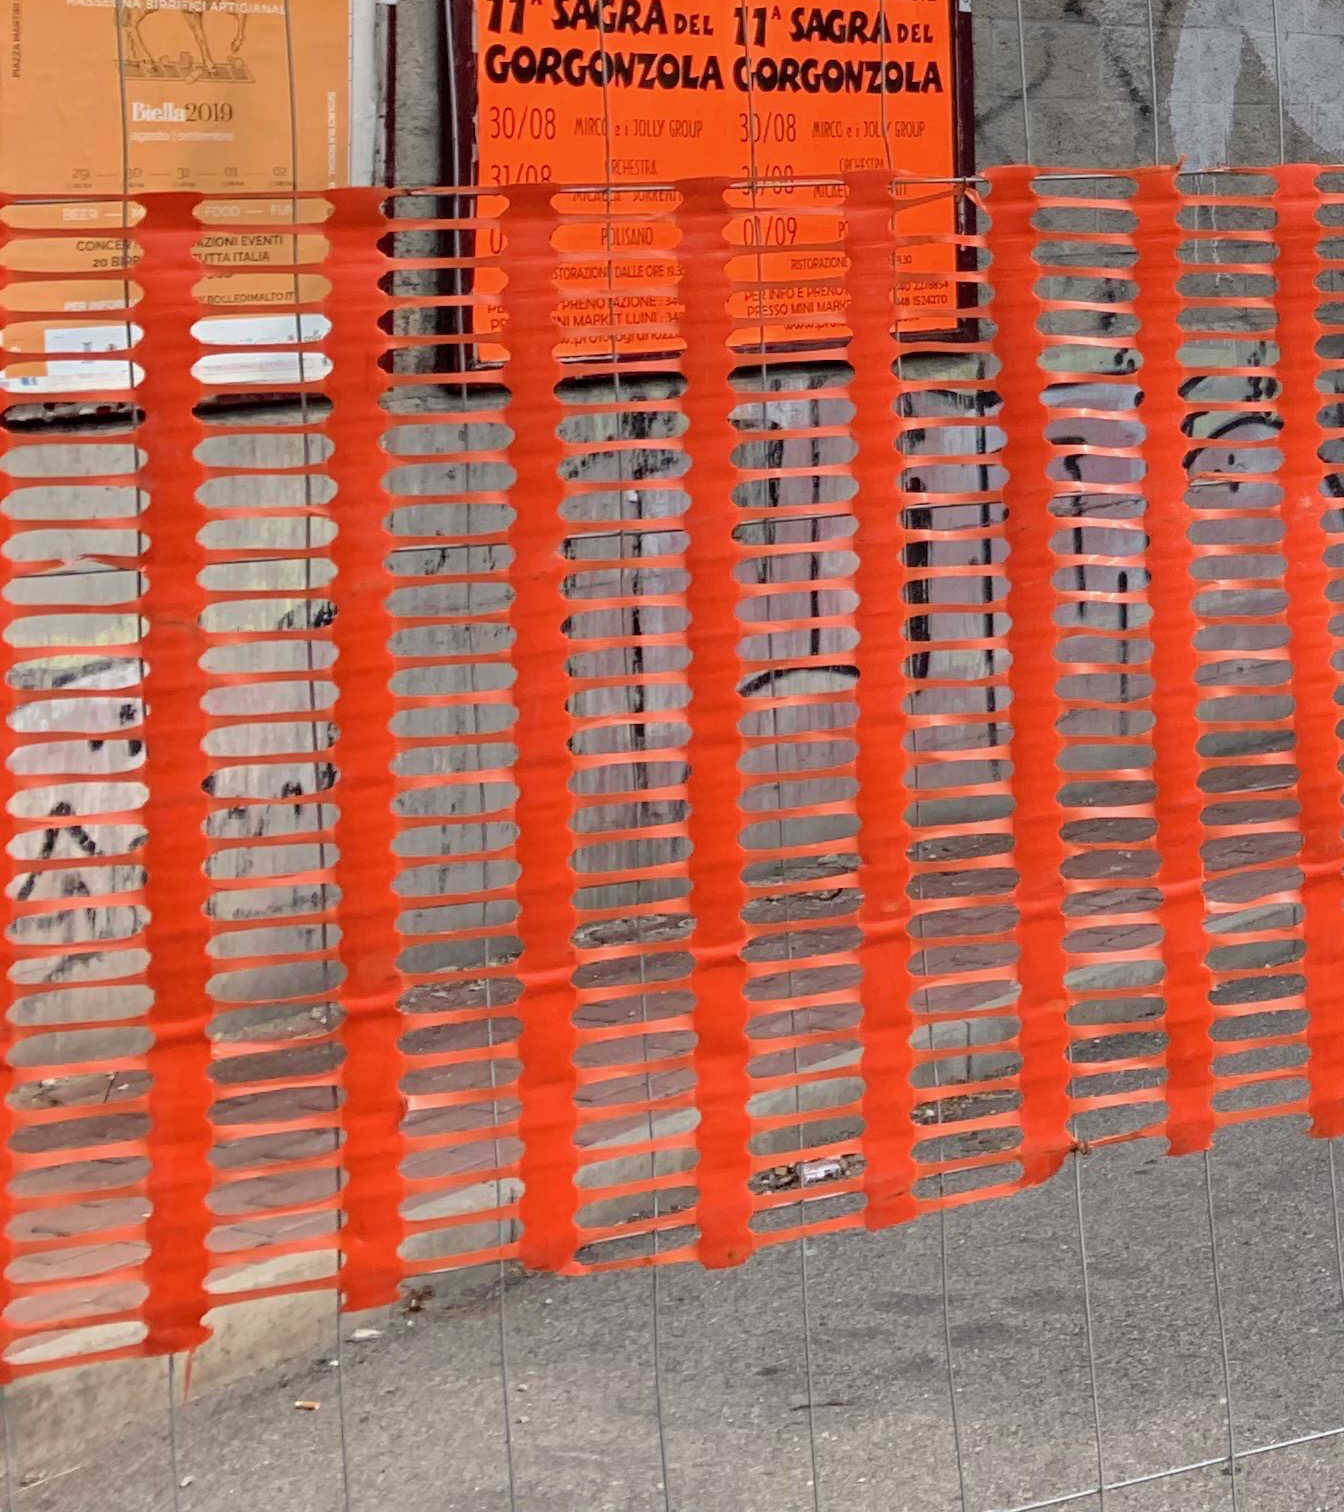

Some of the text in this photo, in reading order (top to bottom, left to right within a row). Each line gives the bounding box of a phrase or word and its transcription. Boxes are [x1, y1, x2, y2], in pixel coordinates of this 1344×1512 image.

[210, 1, 287, 15] ARTIGIANAL
[674, 13, 714, 36] DEL
[790, 7, 891, 45] SAGRA
[897, 23, 933, 43] DEL
[485, 44, 725, 91] GORGONZOLA
[733, 56, 943, 94] GORGONZOLA
[490, 106, 556, 140] 30/08
[633, 119, 664, 138] JOLLY
[669, 120, 703, 138] GROUP
[895, 121, 925, 138] GROUP
[611, 159, 658, 176] RCHESTRA
[204, 206, 241, 218] FOOD
[241, 234, 283, 247] EVENTI
[232, 250, 270, 263] ITALIA
[615, 265, 665, 278] DALLE ORE
[562, 296, 656, 311] PRENOAZIONE
[791, 303, 814, 315] MINI
[573, 313, 622, 326] MARKT
